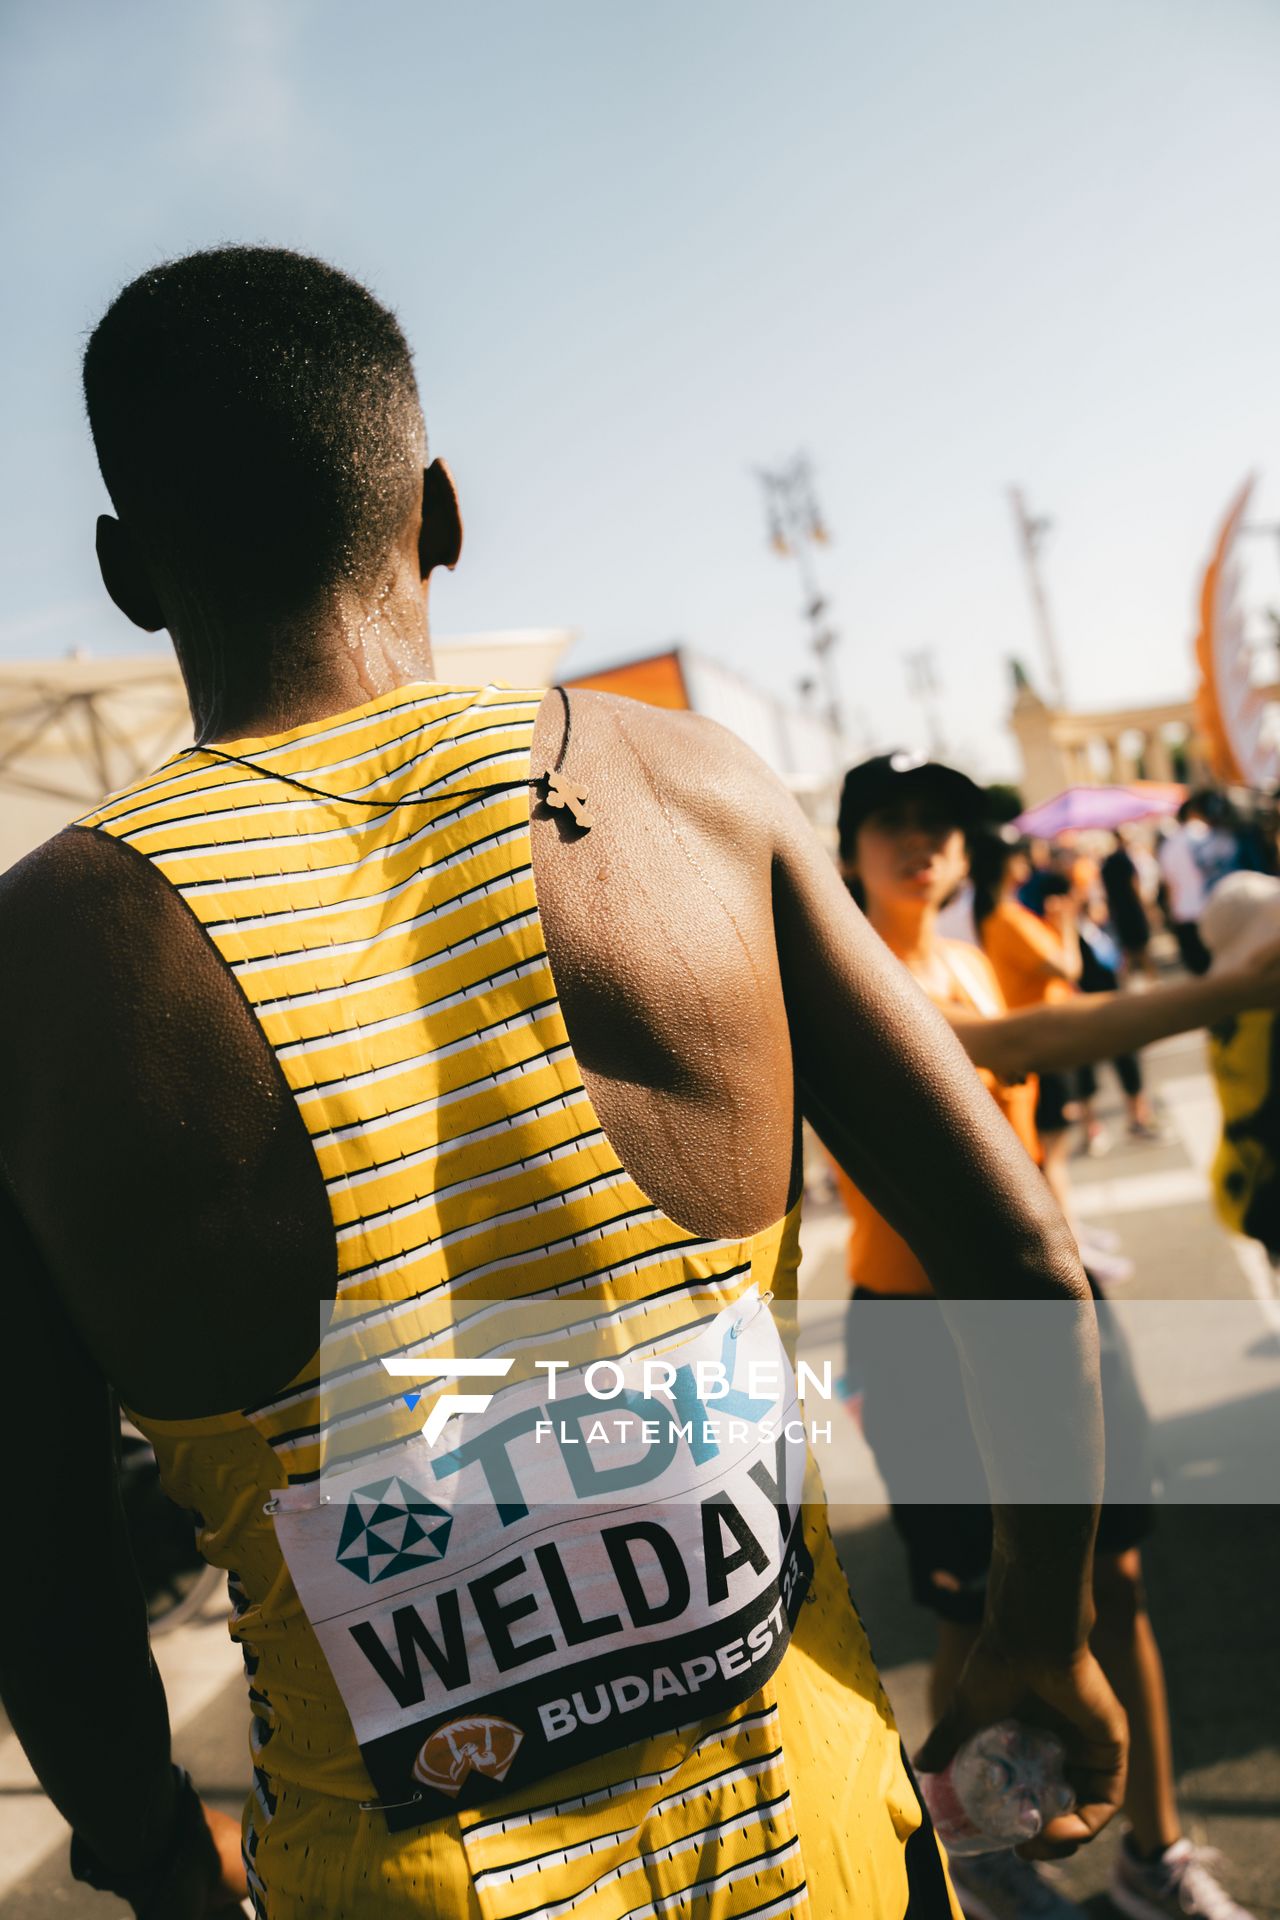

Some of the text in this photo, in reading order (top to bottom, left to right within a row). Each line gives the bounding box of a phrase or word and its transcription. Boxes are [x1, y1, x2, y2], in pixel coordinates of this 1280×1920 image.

[431, 1329, 776, 1527] TDK
[349, 1430, 792, 1709] WELDAY
[538, 1595, 783, 1743] BUDAPEST
